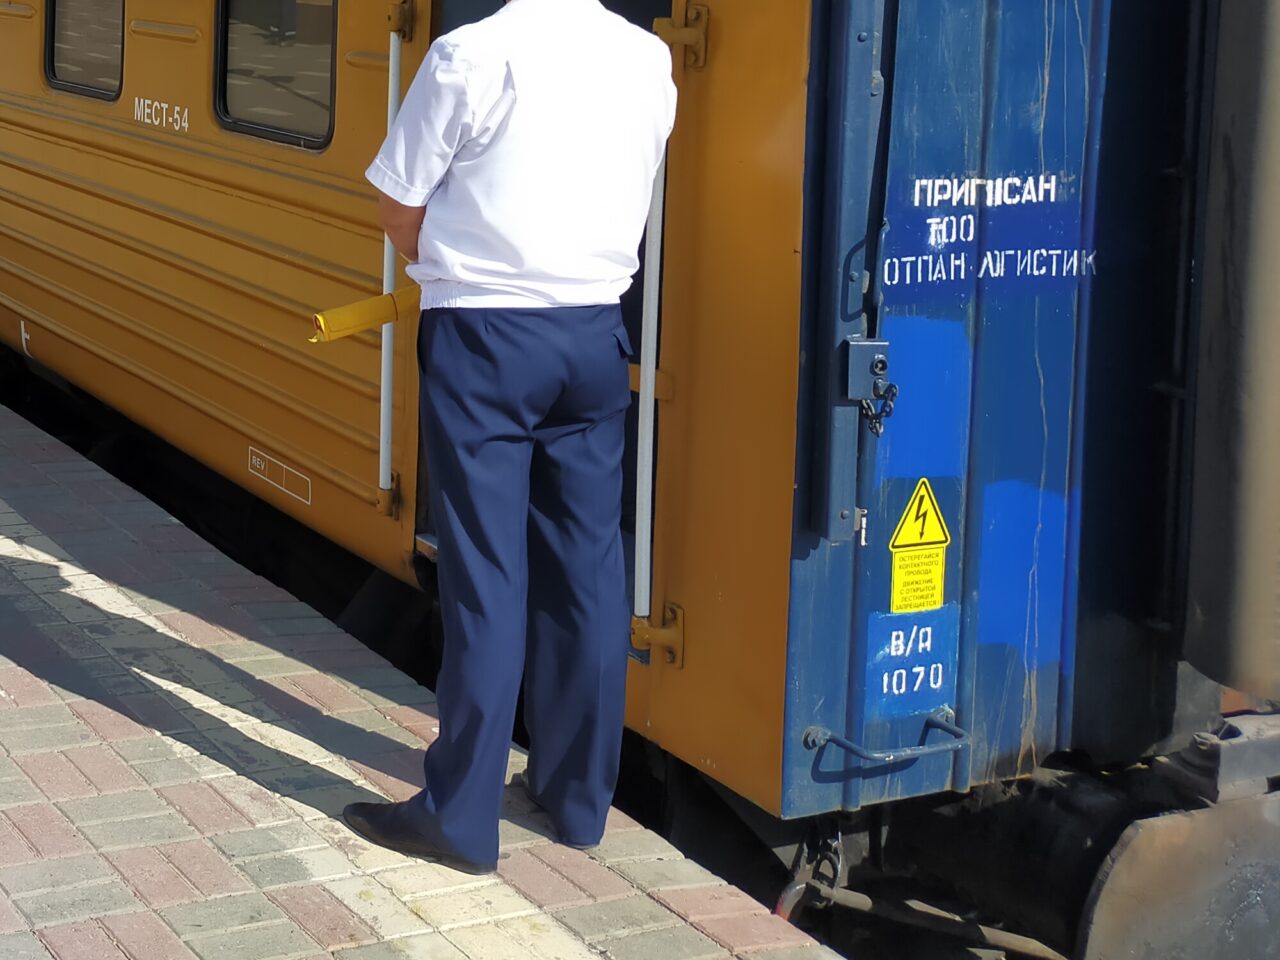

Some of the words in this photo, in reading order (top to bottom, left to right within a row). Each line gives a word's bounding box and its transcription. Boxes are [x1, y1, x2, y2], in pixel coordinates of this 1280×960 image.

[134, 96, 189, 133] МЕСТ-54
[914, 174, 1057, 208] ПРИПИСАН
[883, 252, 966, 285] ОТПАН
[251, 455, 266, 471] REV
[883, 663, 943, 695] 1070
